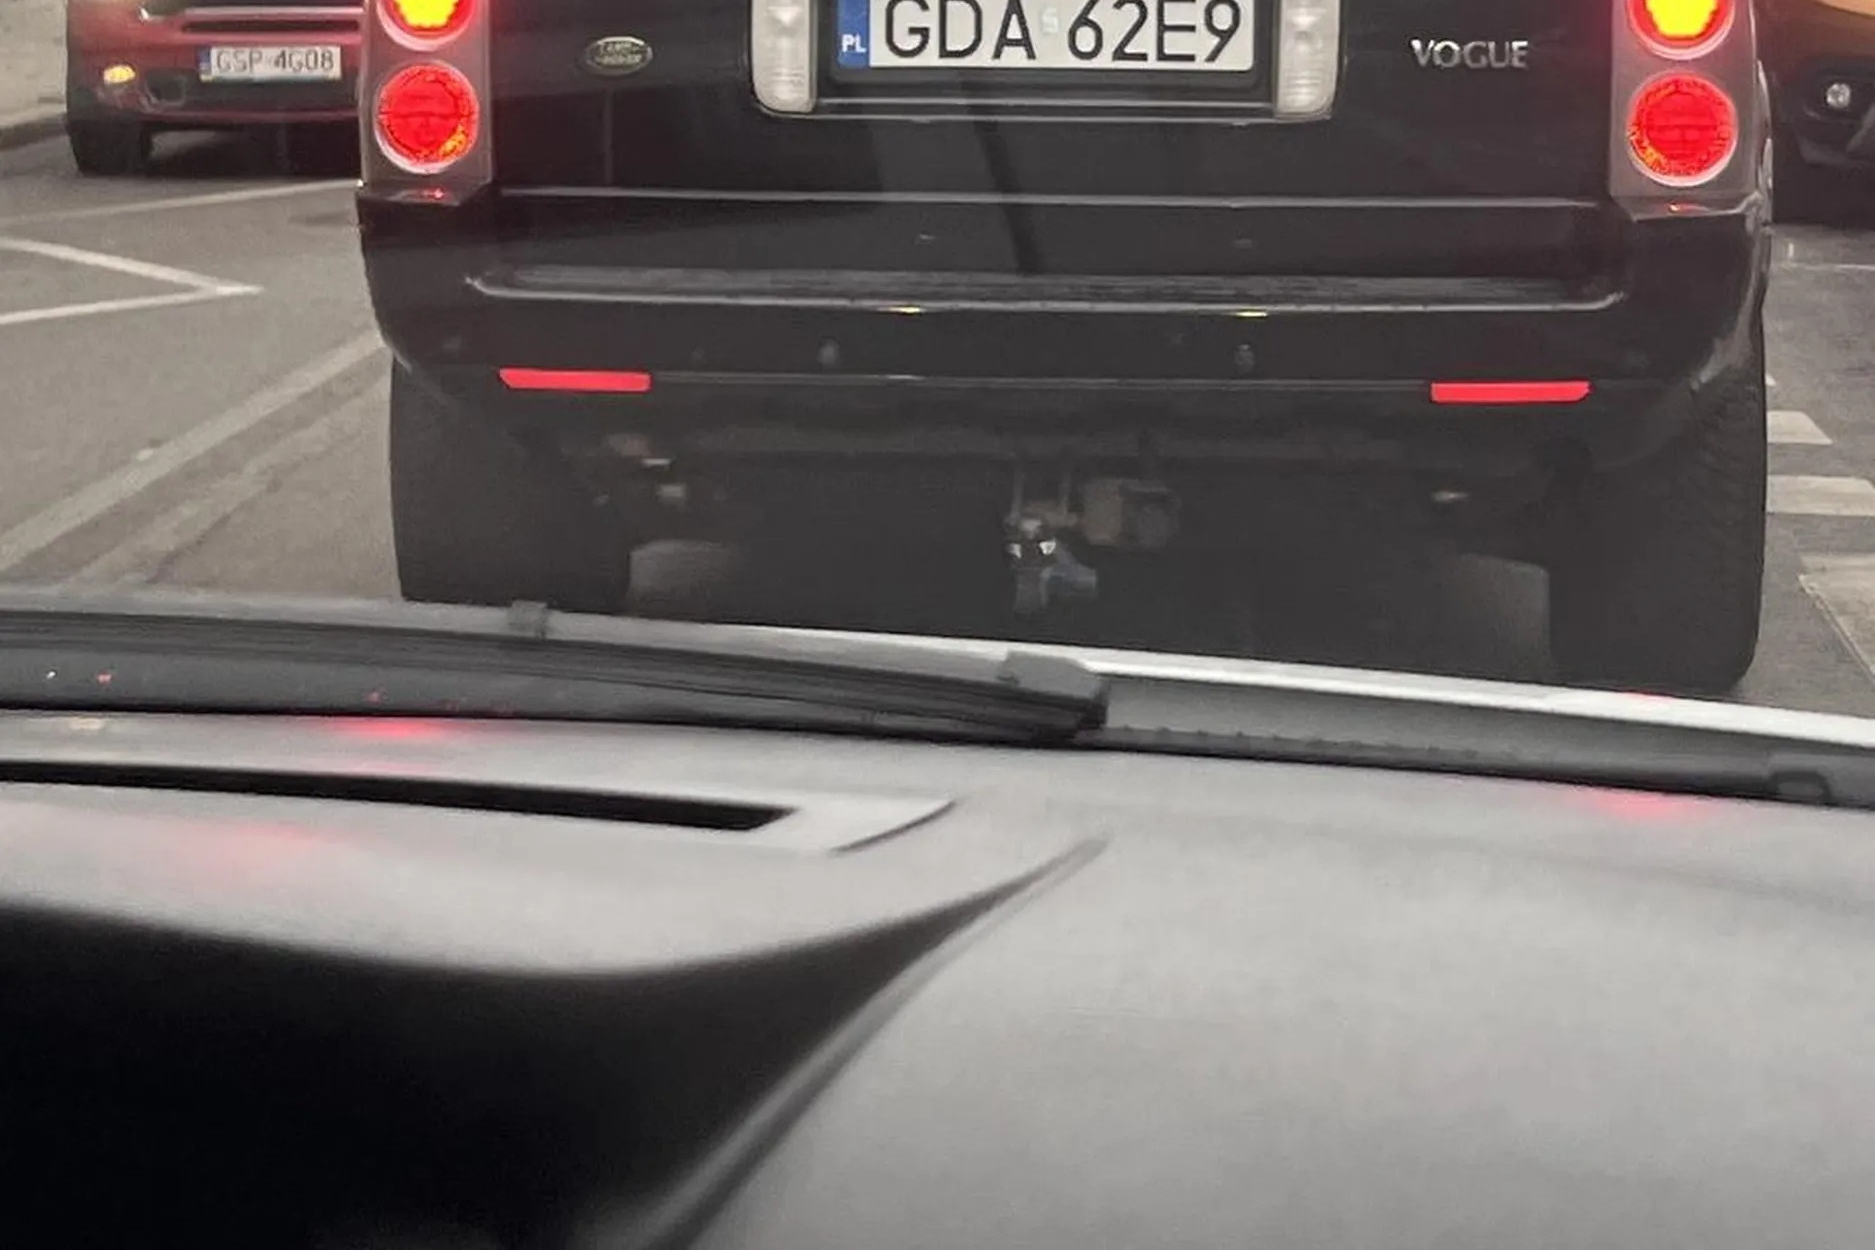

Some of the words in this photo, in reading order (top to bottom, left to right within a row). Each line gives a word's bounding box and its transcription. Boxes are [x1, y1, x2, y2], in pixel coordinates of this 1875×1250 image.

[842, 33, 867, 53] PL
[1410, 39, 1529, 69] VOGUE
[216, 49, 263, 72] GSP
[274, 48, 334, 71] 4G08
